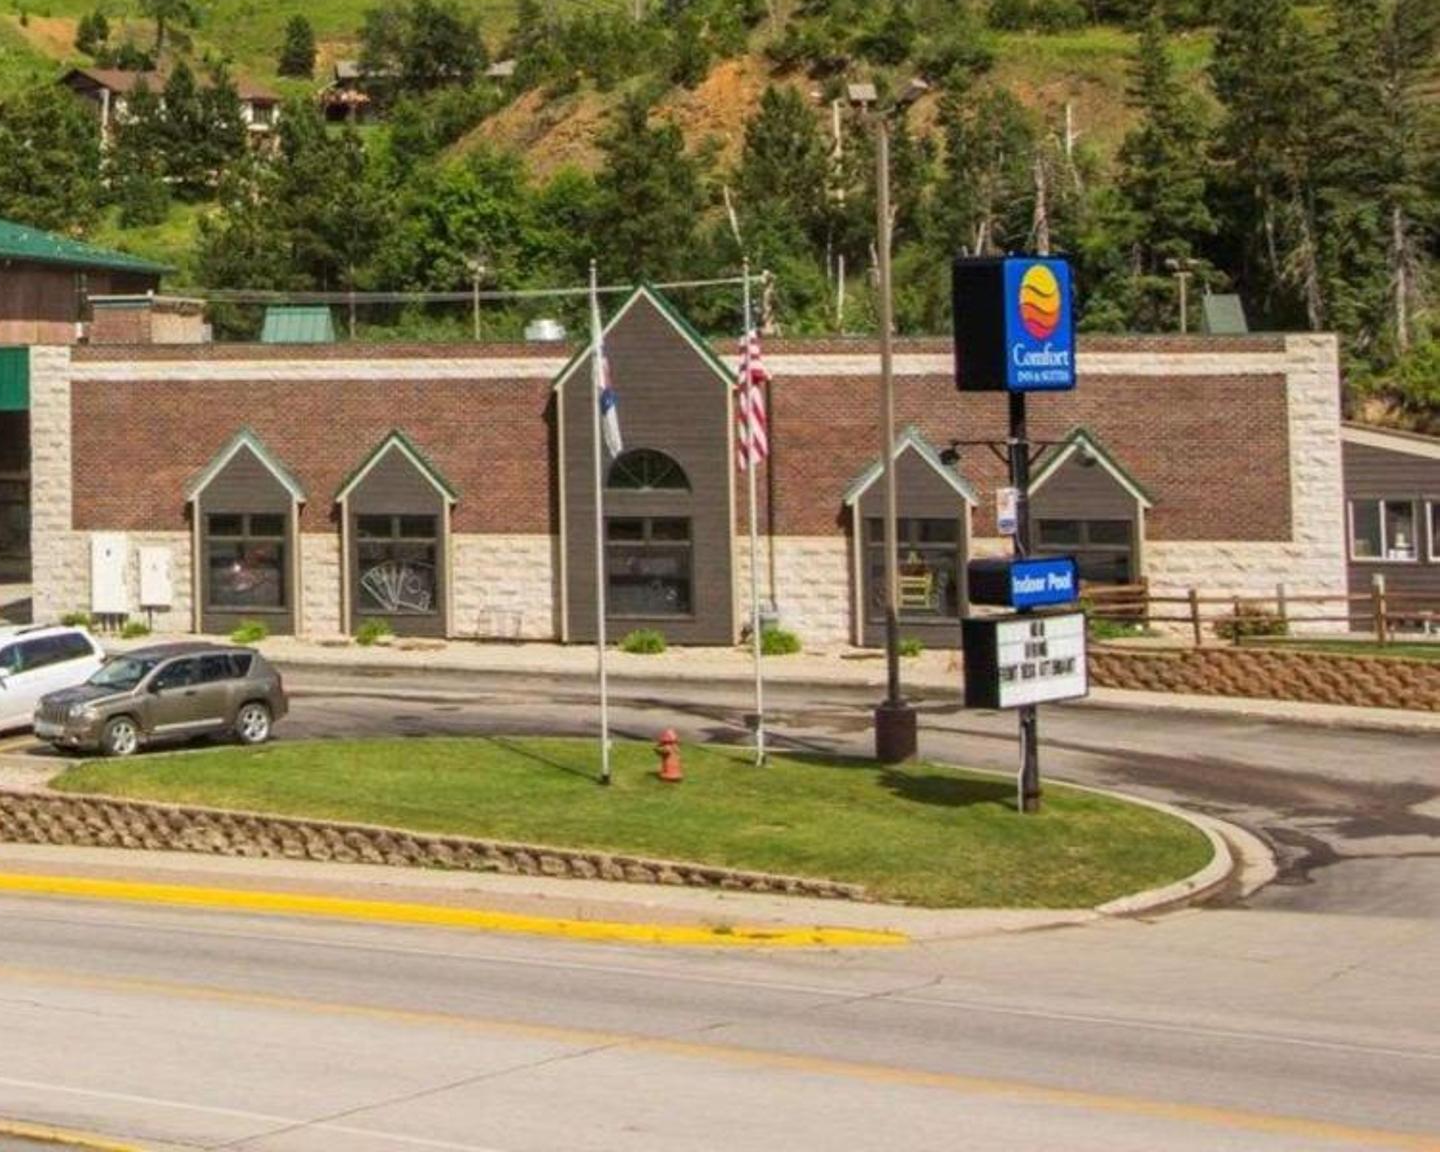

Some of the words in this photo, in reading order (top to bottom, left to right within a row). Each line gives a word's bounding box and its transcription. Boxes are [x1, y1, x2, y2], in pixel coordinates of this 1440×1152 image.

[1013, 342, 1069, 366] Comfort
[1012, 574, 1046, 594] Indoor
[1047, 570, 1072, 591] Pool
